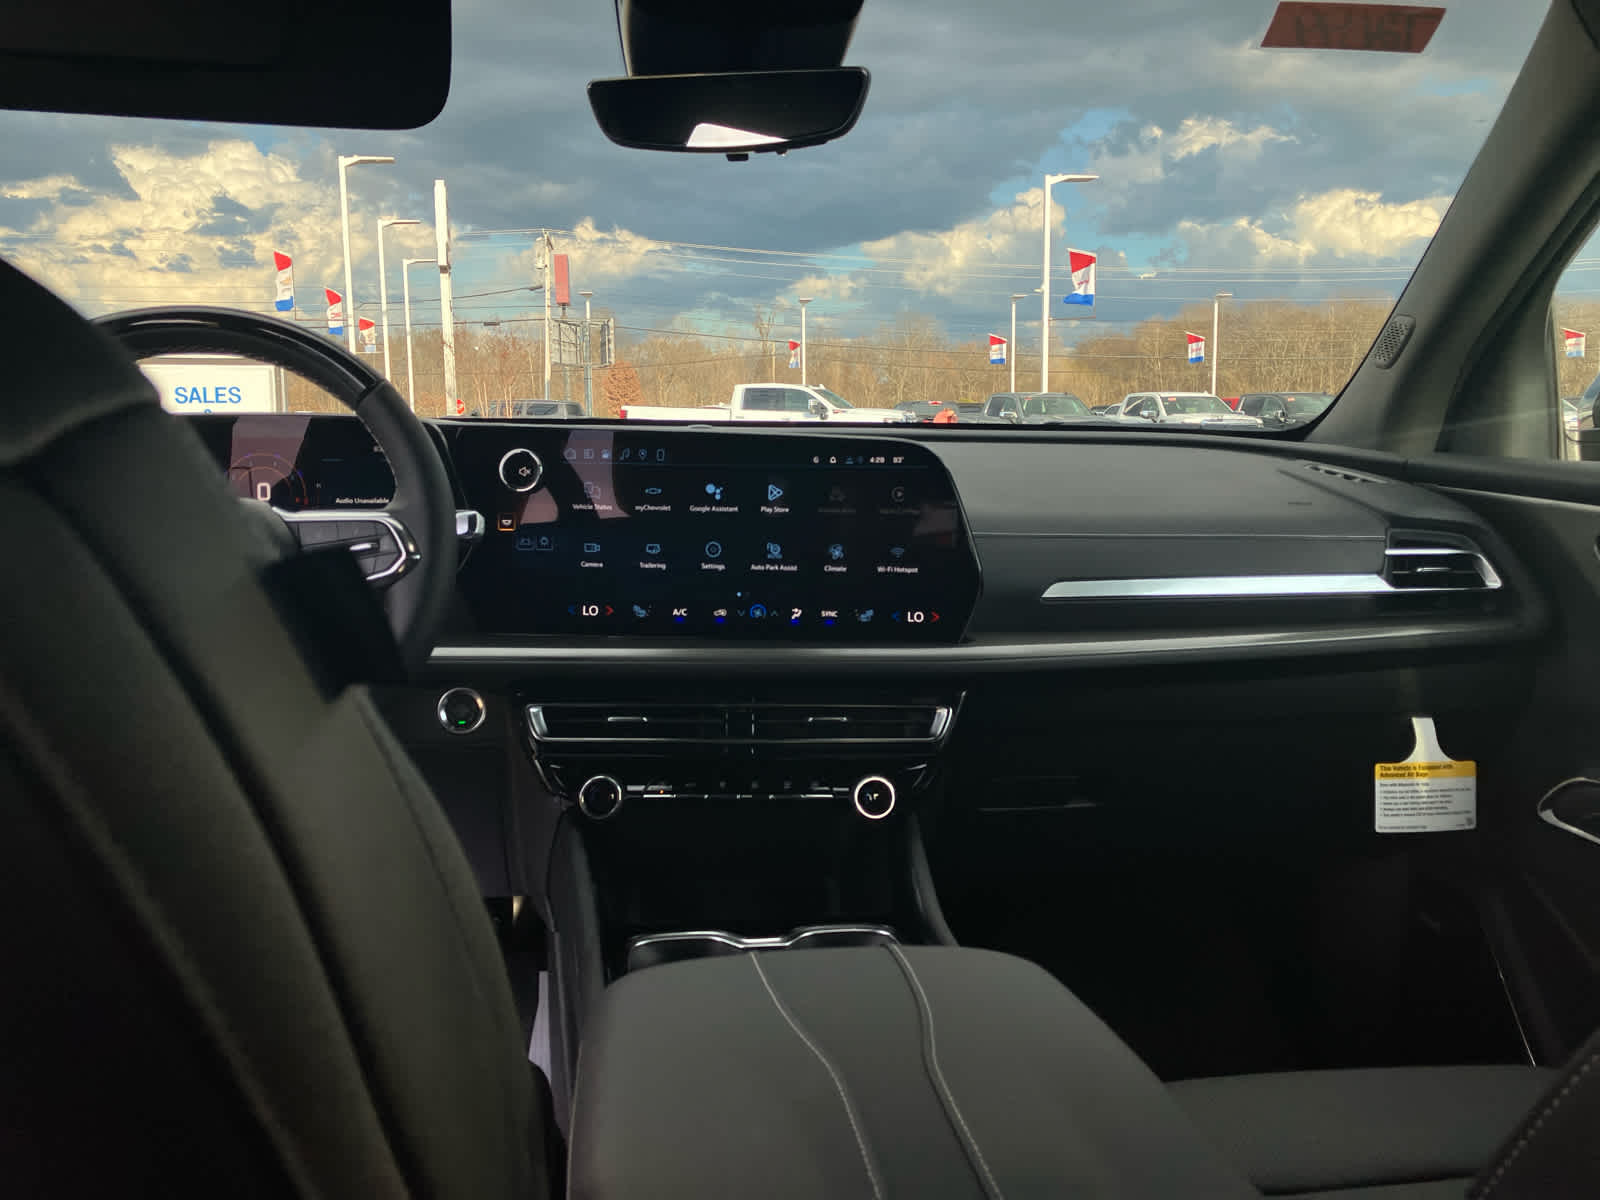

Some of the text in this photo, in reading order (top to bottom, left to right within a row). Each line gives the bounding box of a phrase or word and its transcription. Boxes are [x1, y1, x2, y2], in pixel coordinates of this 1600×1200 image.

[174, 386, 242, 405] SALES
[257, 482, 271, 502] 0
[335, 497, 390, 505] Audio Unavailable
[594, 503, 613, 511] Status
[634, 504, 671, 513] myChevrolet
[689, 504, 739, 514] Google Assistant
[760, 505, 790, 514] Play Store
[580, 560, 604, 568] Camera
[639, 561, 666, 570] Trailering
[701, 562, 725, 571] Settings
[750, 563, 798, 572] Auto Park Assist
[823, 564, 847, 572] Climate
[877, 565, 919, 574] Wi-Fi Hotspot
[582, 604, 599, 617] LO
[672, 607, 688, 617] A/C
[820, 610, 838, 618] SYNC
[907, 611, 925, 623] LO
